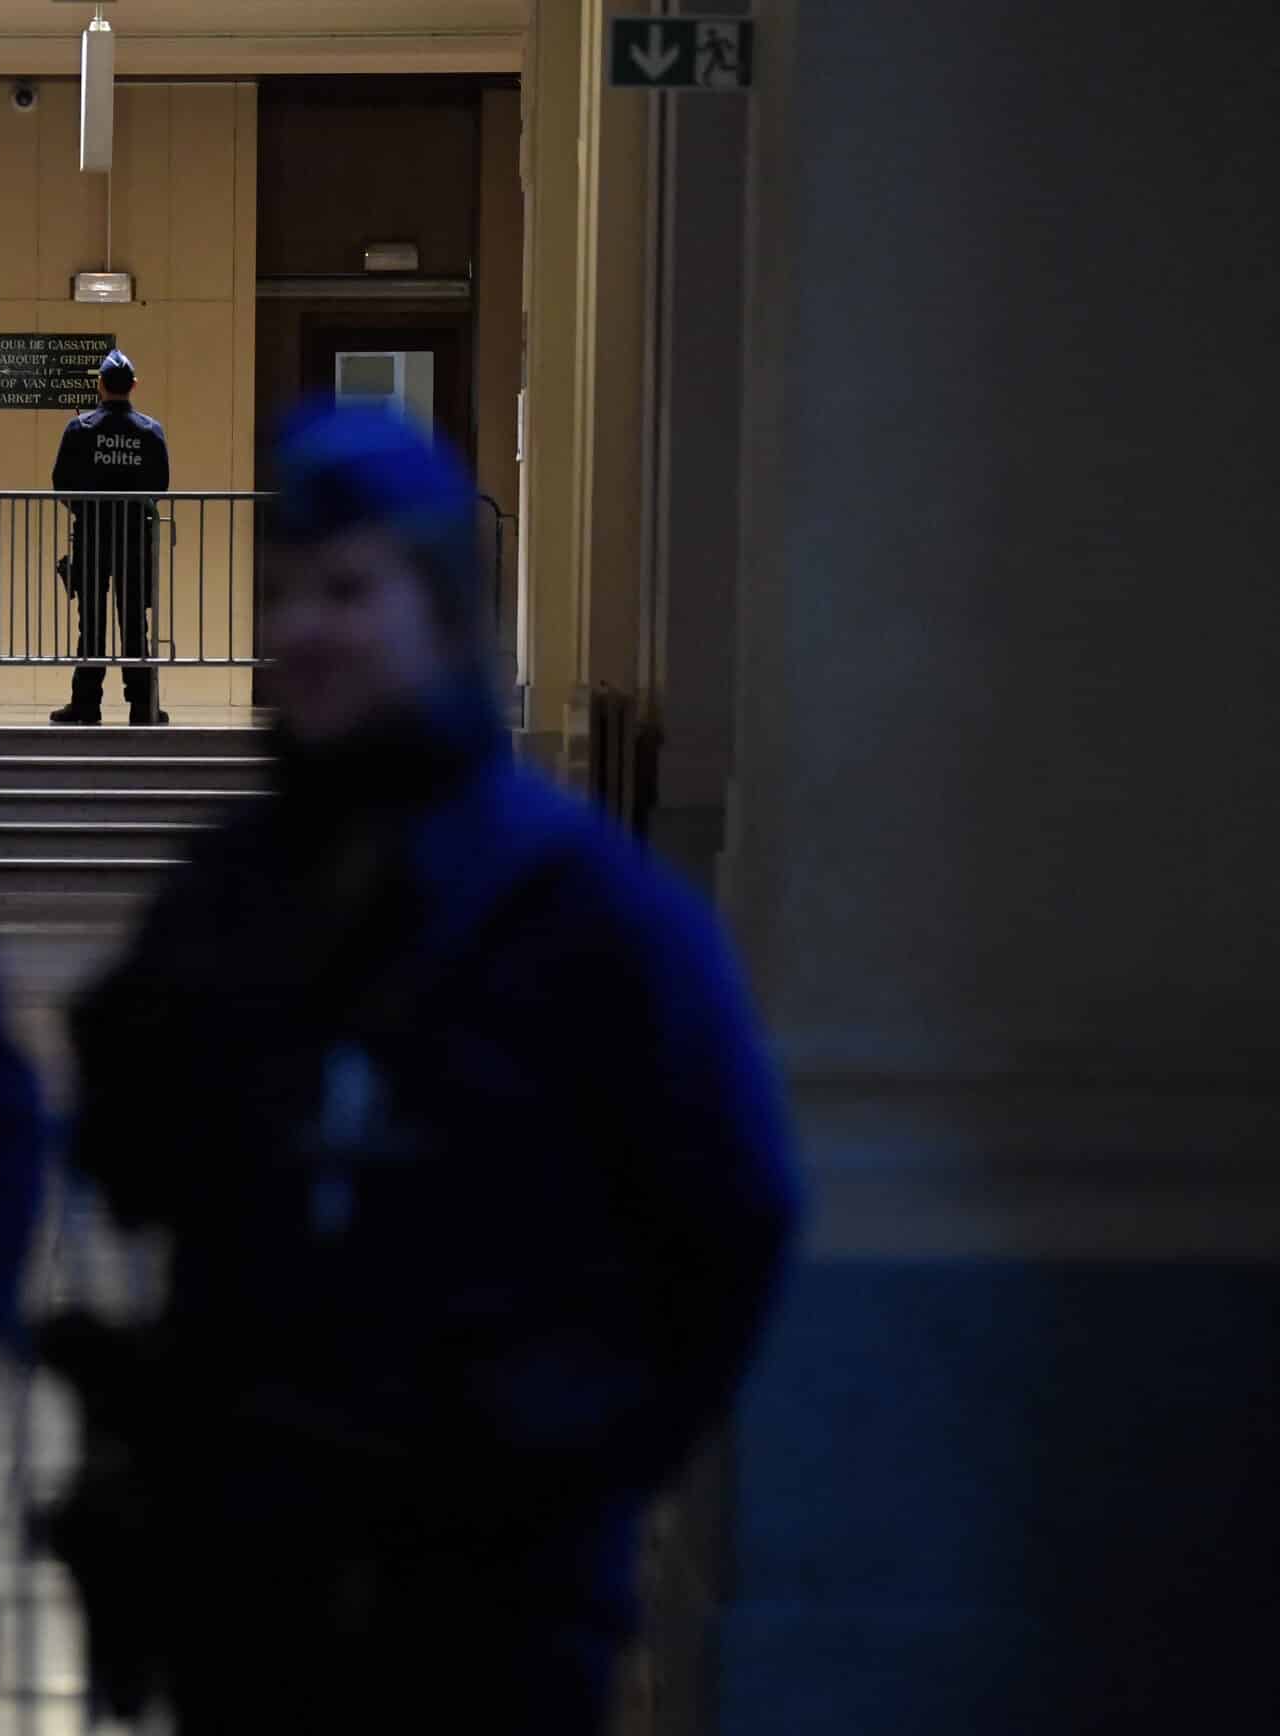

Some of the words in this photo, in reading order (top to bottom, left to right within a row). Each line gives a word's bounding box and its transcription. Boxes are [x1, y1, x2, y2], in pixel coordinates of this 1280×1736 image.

[30, 340, 45, 350] DE
[49, 340, 108, 351] CASSATION
[23, 378, 47, 389] VAN
[50, 379, 98, 389] CASSAT
[58, 394, 98, 404] GRIFFI
[97, 433, 141, 449] Police
[94, 450, 143, 466] Politie
